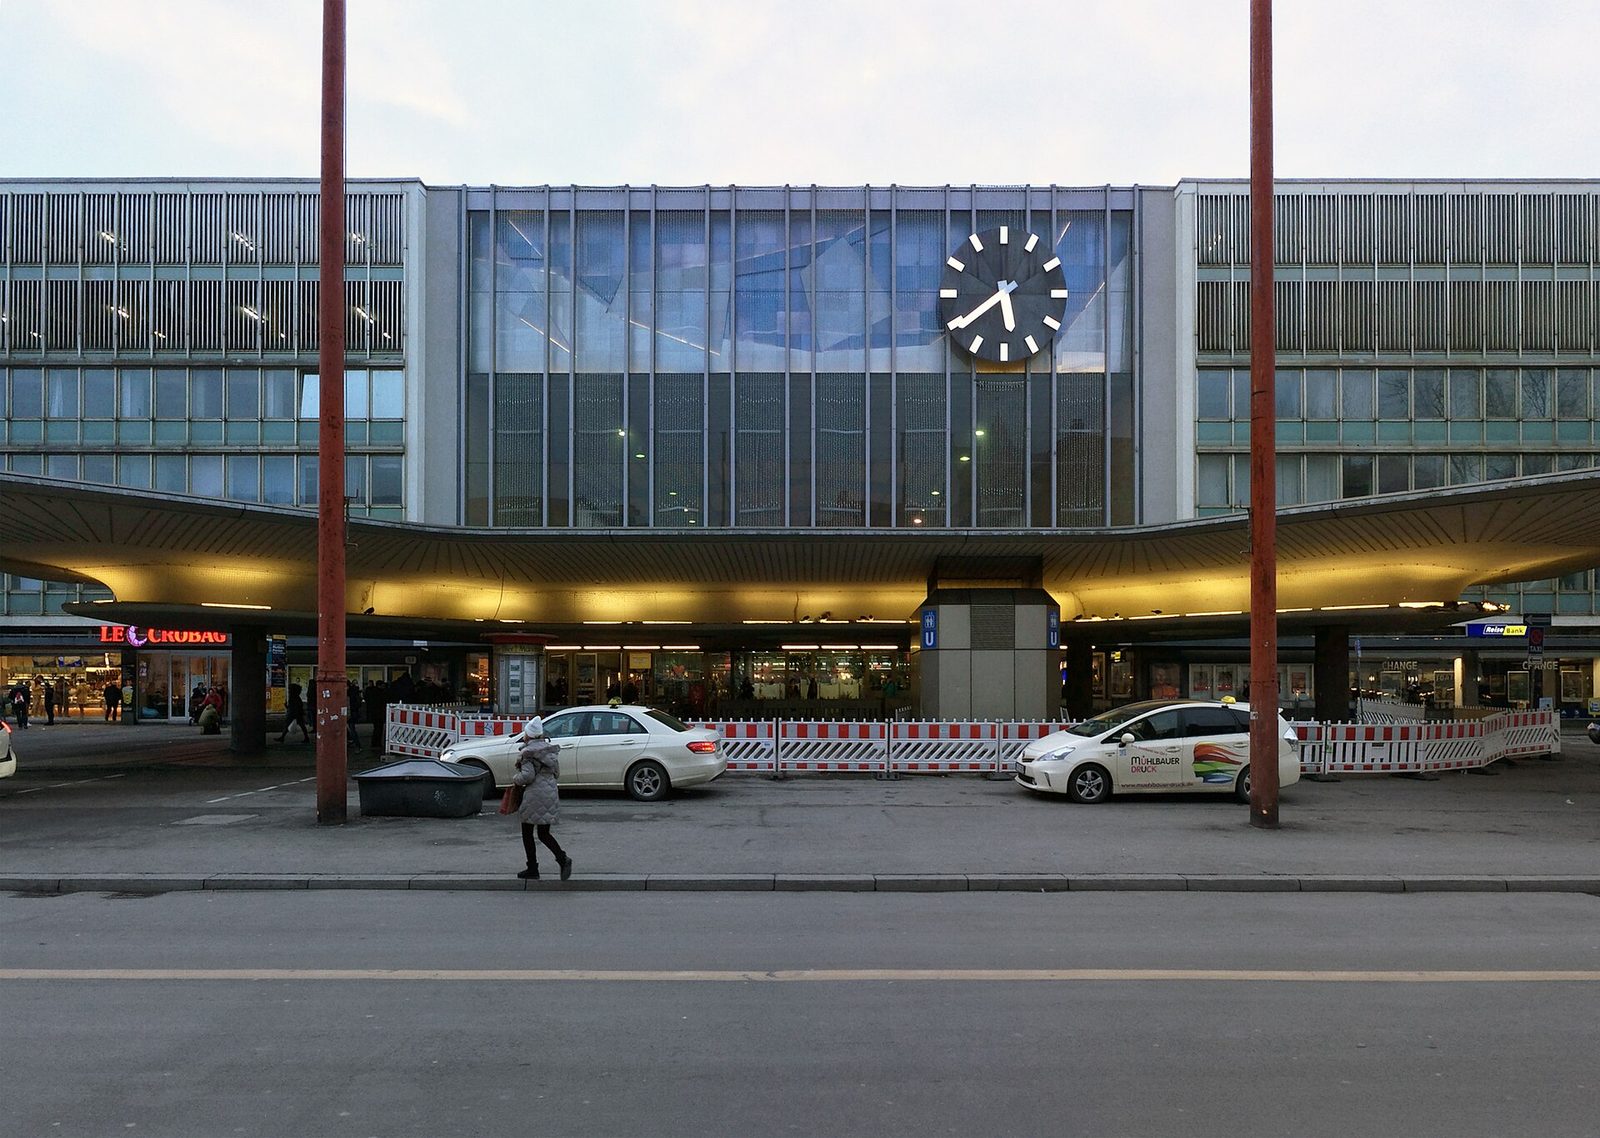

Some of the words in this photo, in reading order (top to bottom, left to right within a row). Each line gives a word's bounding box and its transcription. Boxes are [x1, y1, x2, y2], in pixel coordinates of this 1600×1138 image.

[100, 626, 125, 642] LE
[925, 632, 934, 646] U
[1050, 632, 1058, 646] U
[1382, 661, 1418, 670] CHANGE
[1131, 765, 1157, 773] DRUCK
